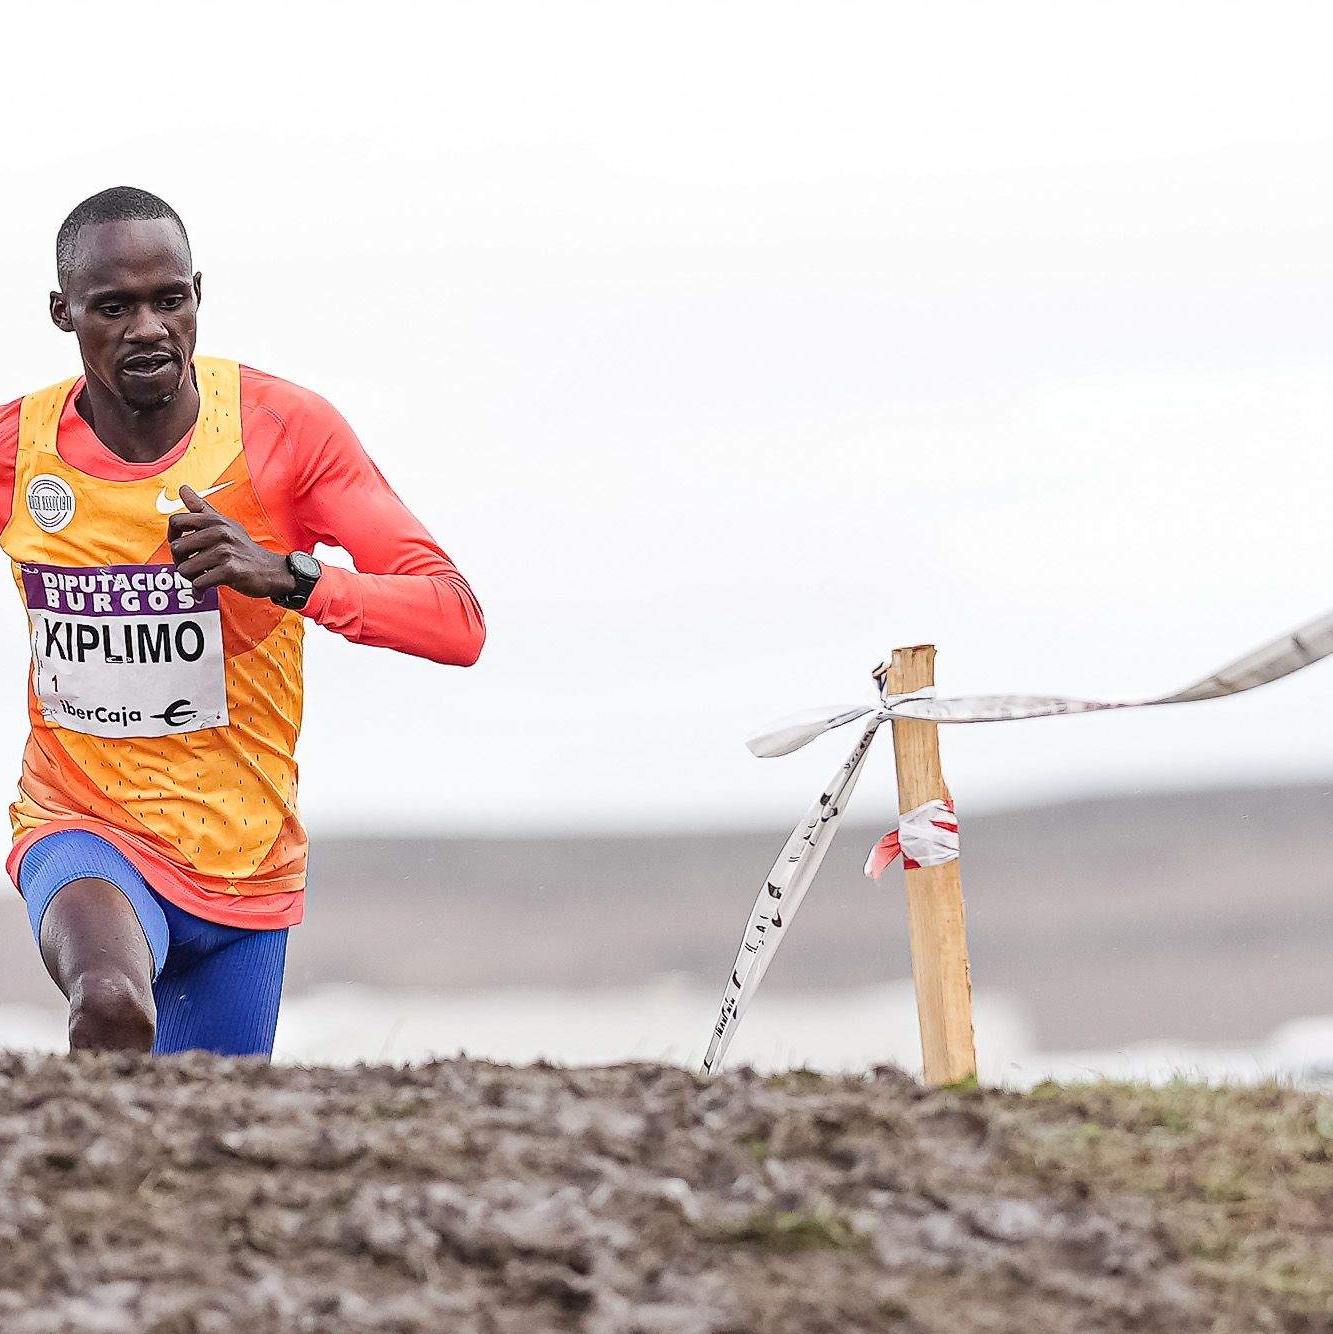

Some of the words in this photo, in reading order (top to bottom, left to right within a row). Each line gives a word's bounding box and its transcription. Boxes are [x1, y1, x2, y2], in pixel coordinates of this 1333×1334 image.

[41, 568, 192, 593] DIPUTACIÓN
[46, 588, 195, 612] BURGOS
[44, 618, 205, 663] KIPLIMO
[51, 674, 59, 693] 1
